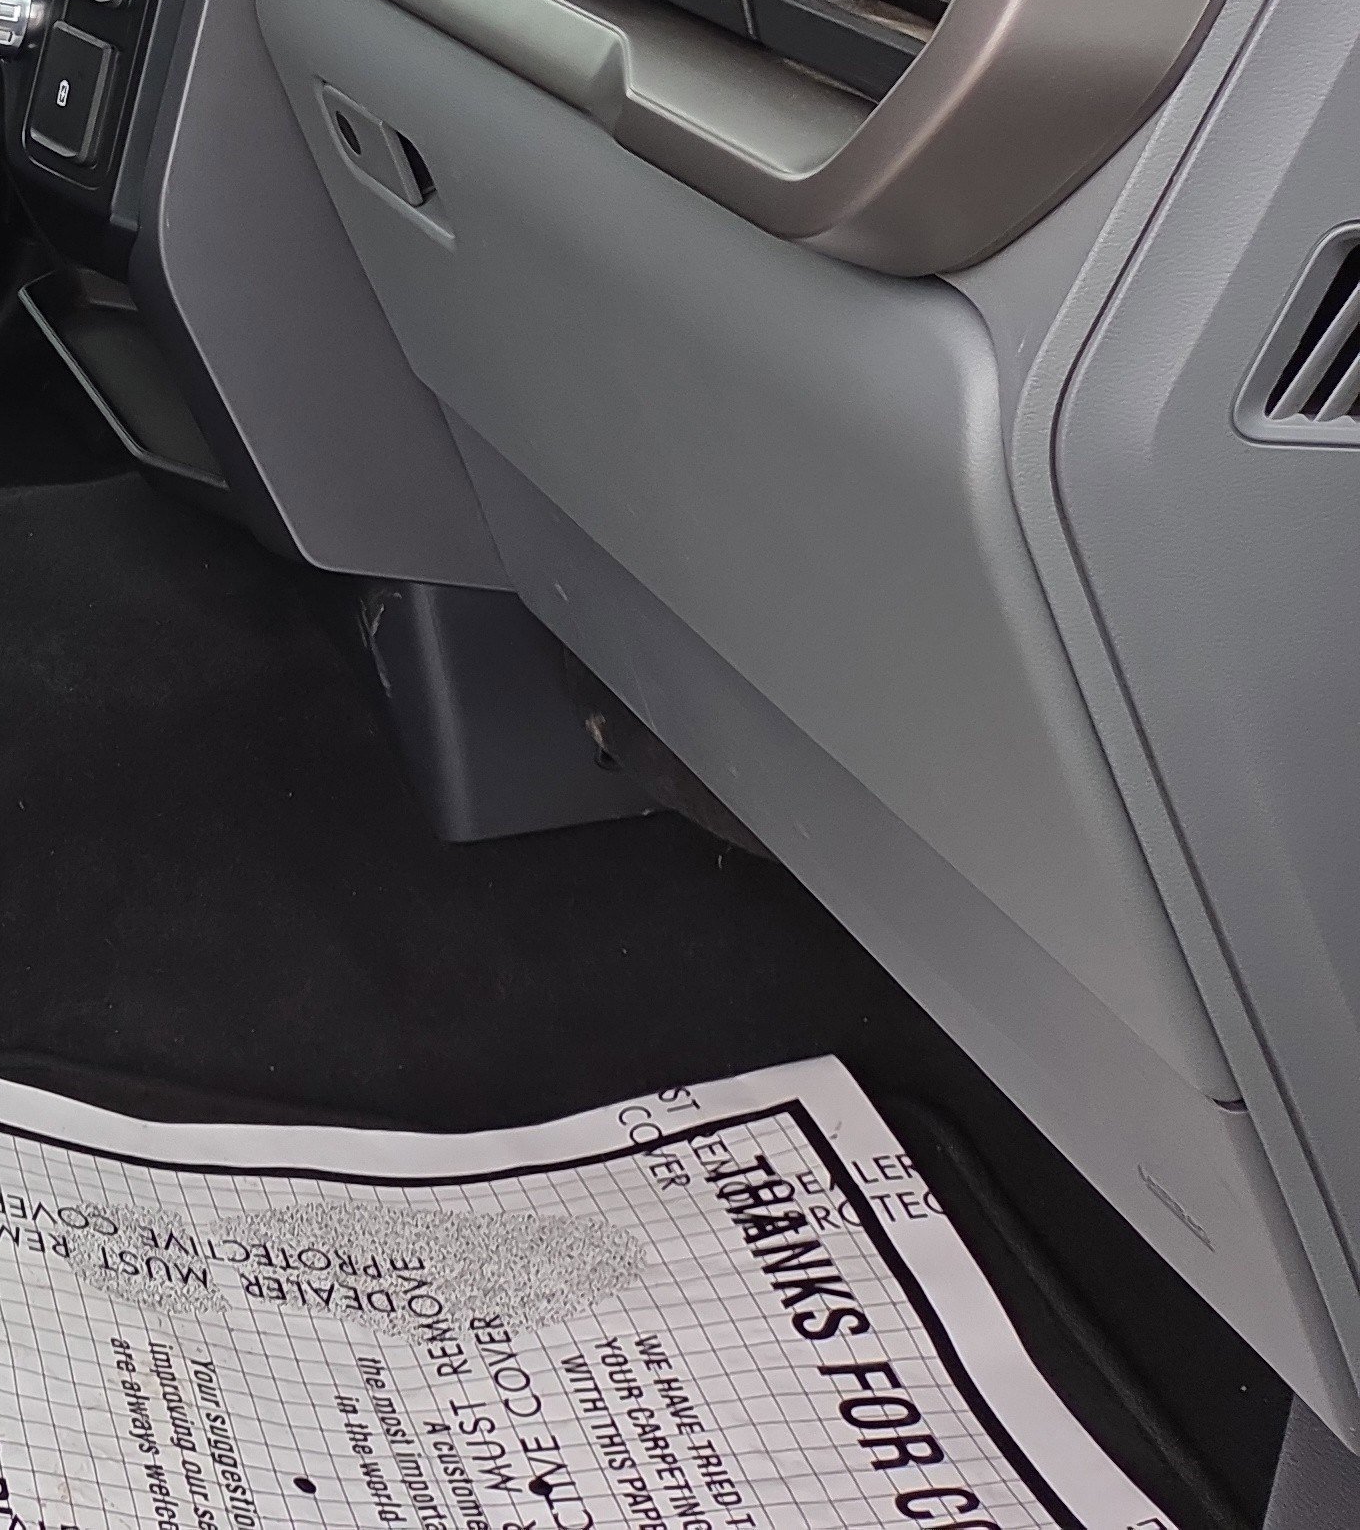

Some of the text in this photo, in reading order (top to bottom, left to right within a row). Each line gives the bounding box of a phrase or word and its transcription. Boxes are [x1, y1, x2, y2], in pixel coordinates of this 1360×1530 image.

[100, 1246, 209, 1289] MUST
[139, 1224, 382, 1281] PROTECTIVE
[239, 1272, 396, 1314] DEALER
[389, 1255, 473, 1378] REMOVE
[706, 1153, 871, 1342] THANKS
[817, 1361, 945, 1471] FOR
[110, 1337, 137, 1373] are
[190, 1358, 222, 1408] Your
[469, 1314, 542, 1418] COVER
[594, 1336, 644, 1401] YOUR
[634, 1334, 673, 1371] WE
[120, 1378, 160, 1456] always
[148, 1340, 198, 1454] improving
[181, 1457, 210, 1502] our
[357, 1355, 385, 1390] the
[371, 1394, 415, 1446] most
[423, 1421, 452, 1435] A
[560, 1354, 608, 1413] WITH
[590, 1420, 637, 1471] THIS
[653, 1377, 705, 1436] HAVE
[334, 1393, 408, 1522] in the world
[448, 1399, 523, 1493] MUST
[687, 1439, 742, 1507] TRIED
